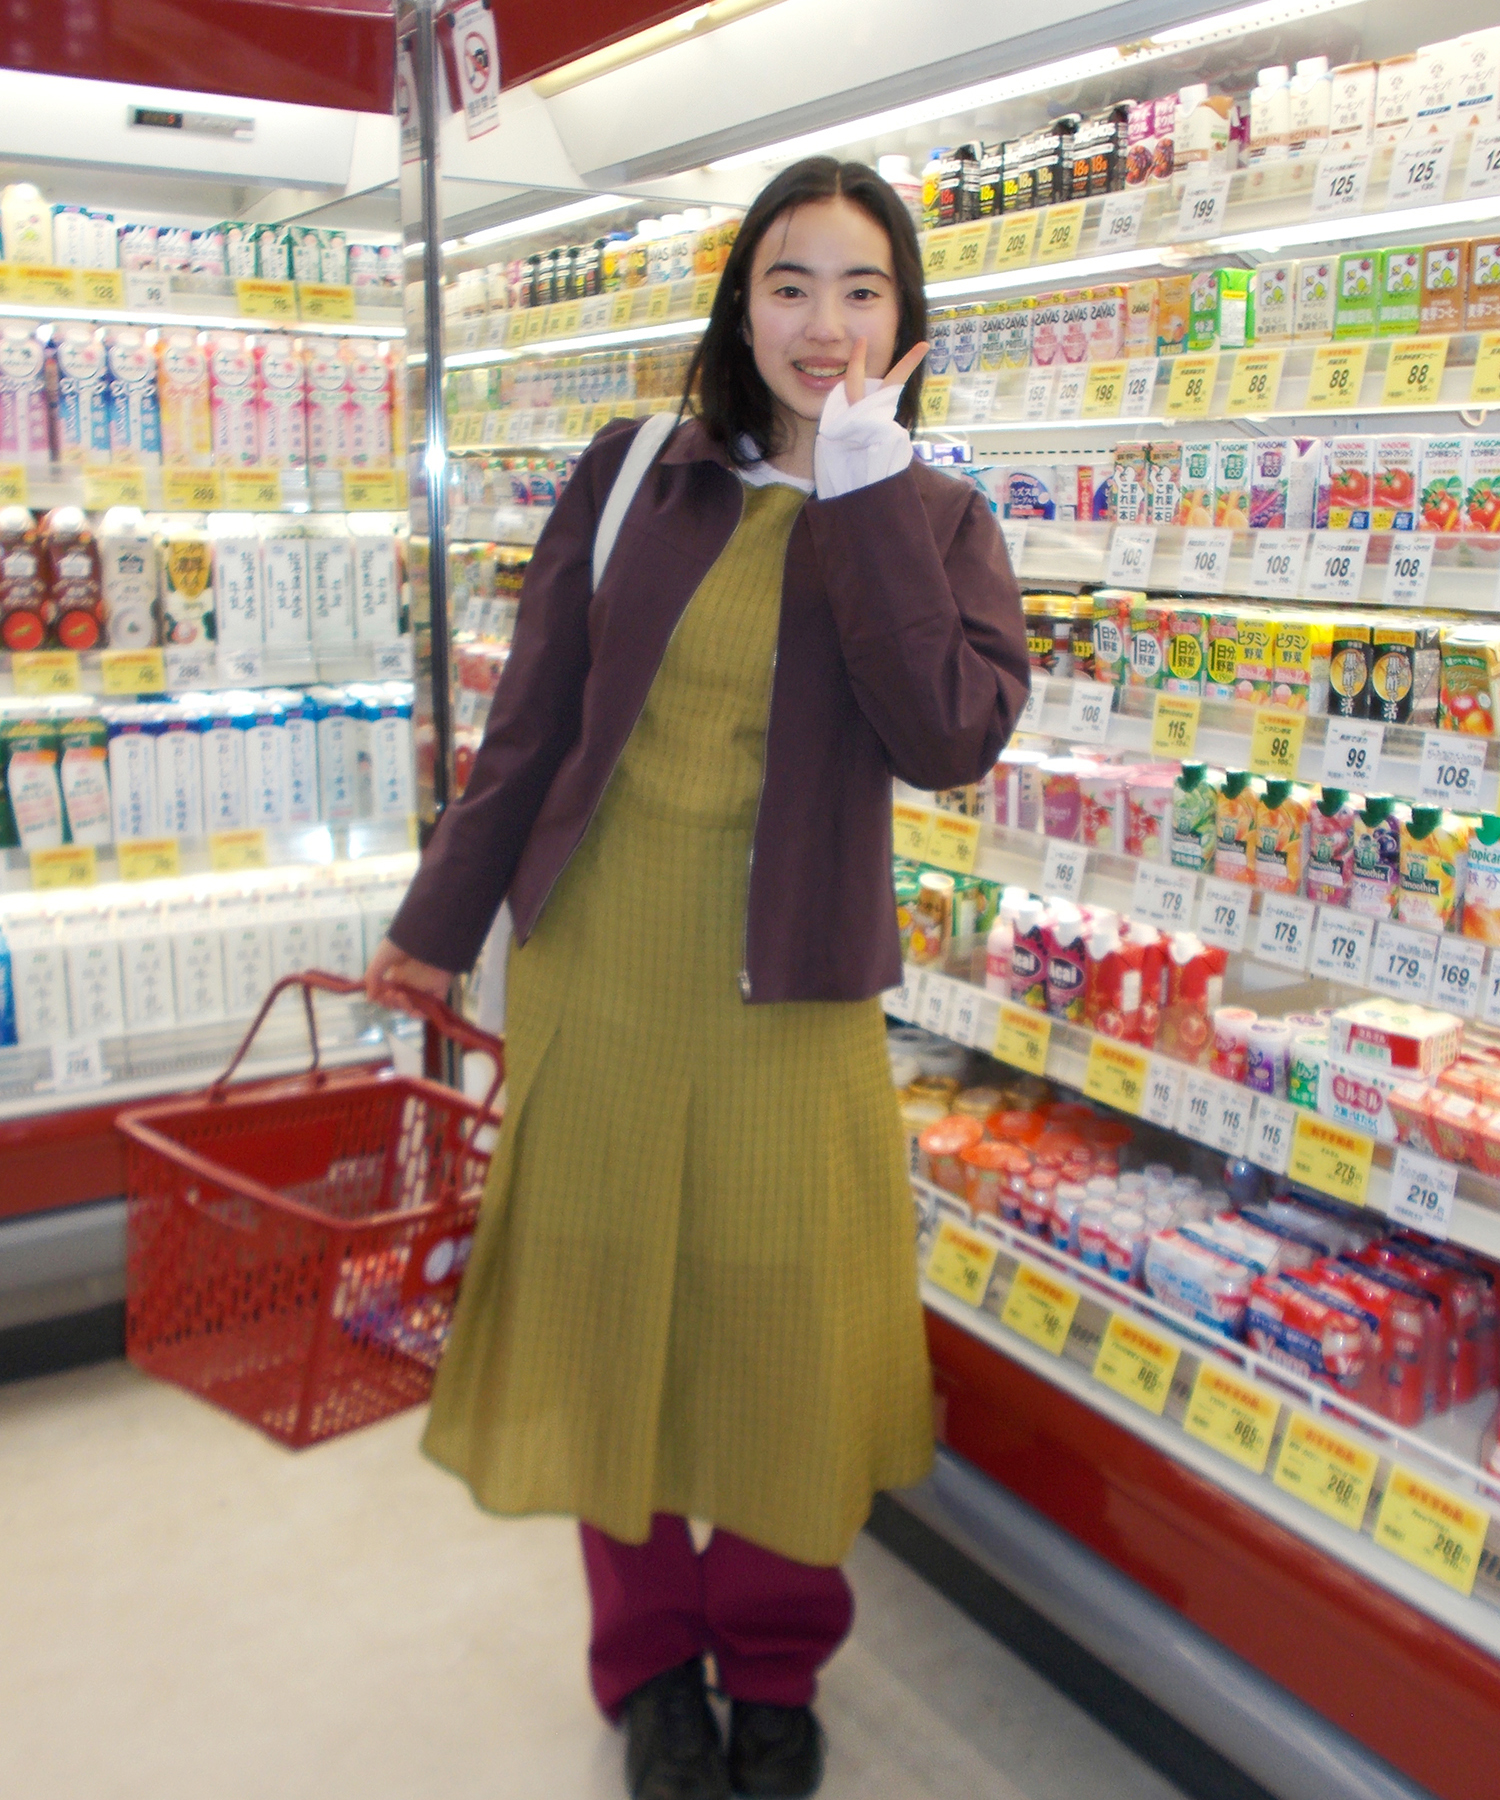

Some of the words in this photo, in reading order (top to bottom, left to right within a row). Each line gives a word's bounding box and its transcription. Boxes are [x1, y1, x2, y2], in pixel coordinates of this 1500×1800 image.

[1486, 149, 1500, 170] 12
[1408, 160, 1436, 184] 125
[1330, 174, 1355, 196] 125
[1192, 199, 1215, 220] 199
[1110, 216, 1132, 234] 199
[1006, 234, 1026, 252] 209
[1050, 225, 1070, 244] 209
[928, 250, 946, 267] 209
[960, 243, 978, 261] 209
[1330, 369, 1349, 388] 88
[1408, 364, 1429, 384] 88
[1096, 384, 1114, 400] 198
[1128, 379, 1146, 394] 128
[1186, 378, 1202, 396] 88
[1249, 375, 1266, 392] 88
[1186, 444, 1212, 452] KAGOME
[1221, 444, 1248, 452] KAGOME
[1258, 441, 1288, 450] KAGOME
[1381, 442, 1410, 450] KAGOME
[1429, 441, 1461, 450] KAGOME
[1192, 468, 1204, 477] 100
[1228, 468, 1240, 478] 100
[1265, 467, 1278, 476] 100
[1120, 484, 1128, 521] これ一本
[1130, 484, 1138, 522] 野菜一日
[1155, 484, 1164, 521] これ一本
[1166, 484, 1174, 522] 野菜一日
[1122, 548, 1142, 566] 108
[1194, 552, 1216, 570] 108
[1266, 556, 1290, 574] 108
[1324, 558, 1350, 578] 108
[1394, 558, 1420, 578] 108
[1102, 641, 1118, 652] 野菜
[1238, 631, 1270, 646] ビタミン
[1276, 634, 1309, 650] ビタミン
[1139, 655, 1156, 666] 野菜
[1178, 656, 1196, 668] 野菜
[1244, 648, 1263, 660] 野菜
[1282, 650, 1302, 664] 野菜
[1217, 662, 1234, 673] 野菜
[1341, 652, 1356, 715] 黒酢で活
[1384, 656, 1399, 720] 黒酢で活
[1082, 705, 1099, 722] 108
[1168, 720, 1186, 738] 115
[1270, 738, 1288, 757] 98
[1346, 748, 1366, 769] 99
[1437, 764, 1470, 788] 108
[1056, 864, 1074, 882] 169
[1162, 891, 1183, 911] 179
[1214, 906, 1236, 927] 179
[1275, 922, 1298, 944] 179
[1332, 936, 1356, 960] 179
[1389, 954, 1420, 980] 179
[1441, 964, 1470, 987] 169
[1335, 1078, 1382, 1114] ミルミル
[1190, 1097, 1207, 1117] 115
[1222, 1110, 1240, 1130] 115
[1262, 1124, 1281, 1144] 115
[1334, 1161, 1356, 1181] 275
[1406, 1184, 1439, 1210] 219
